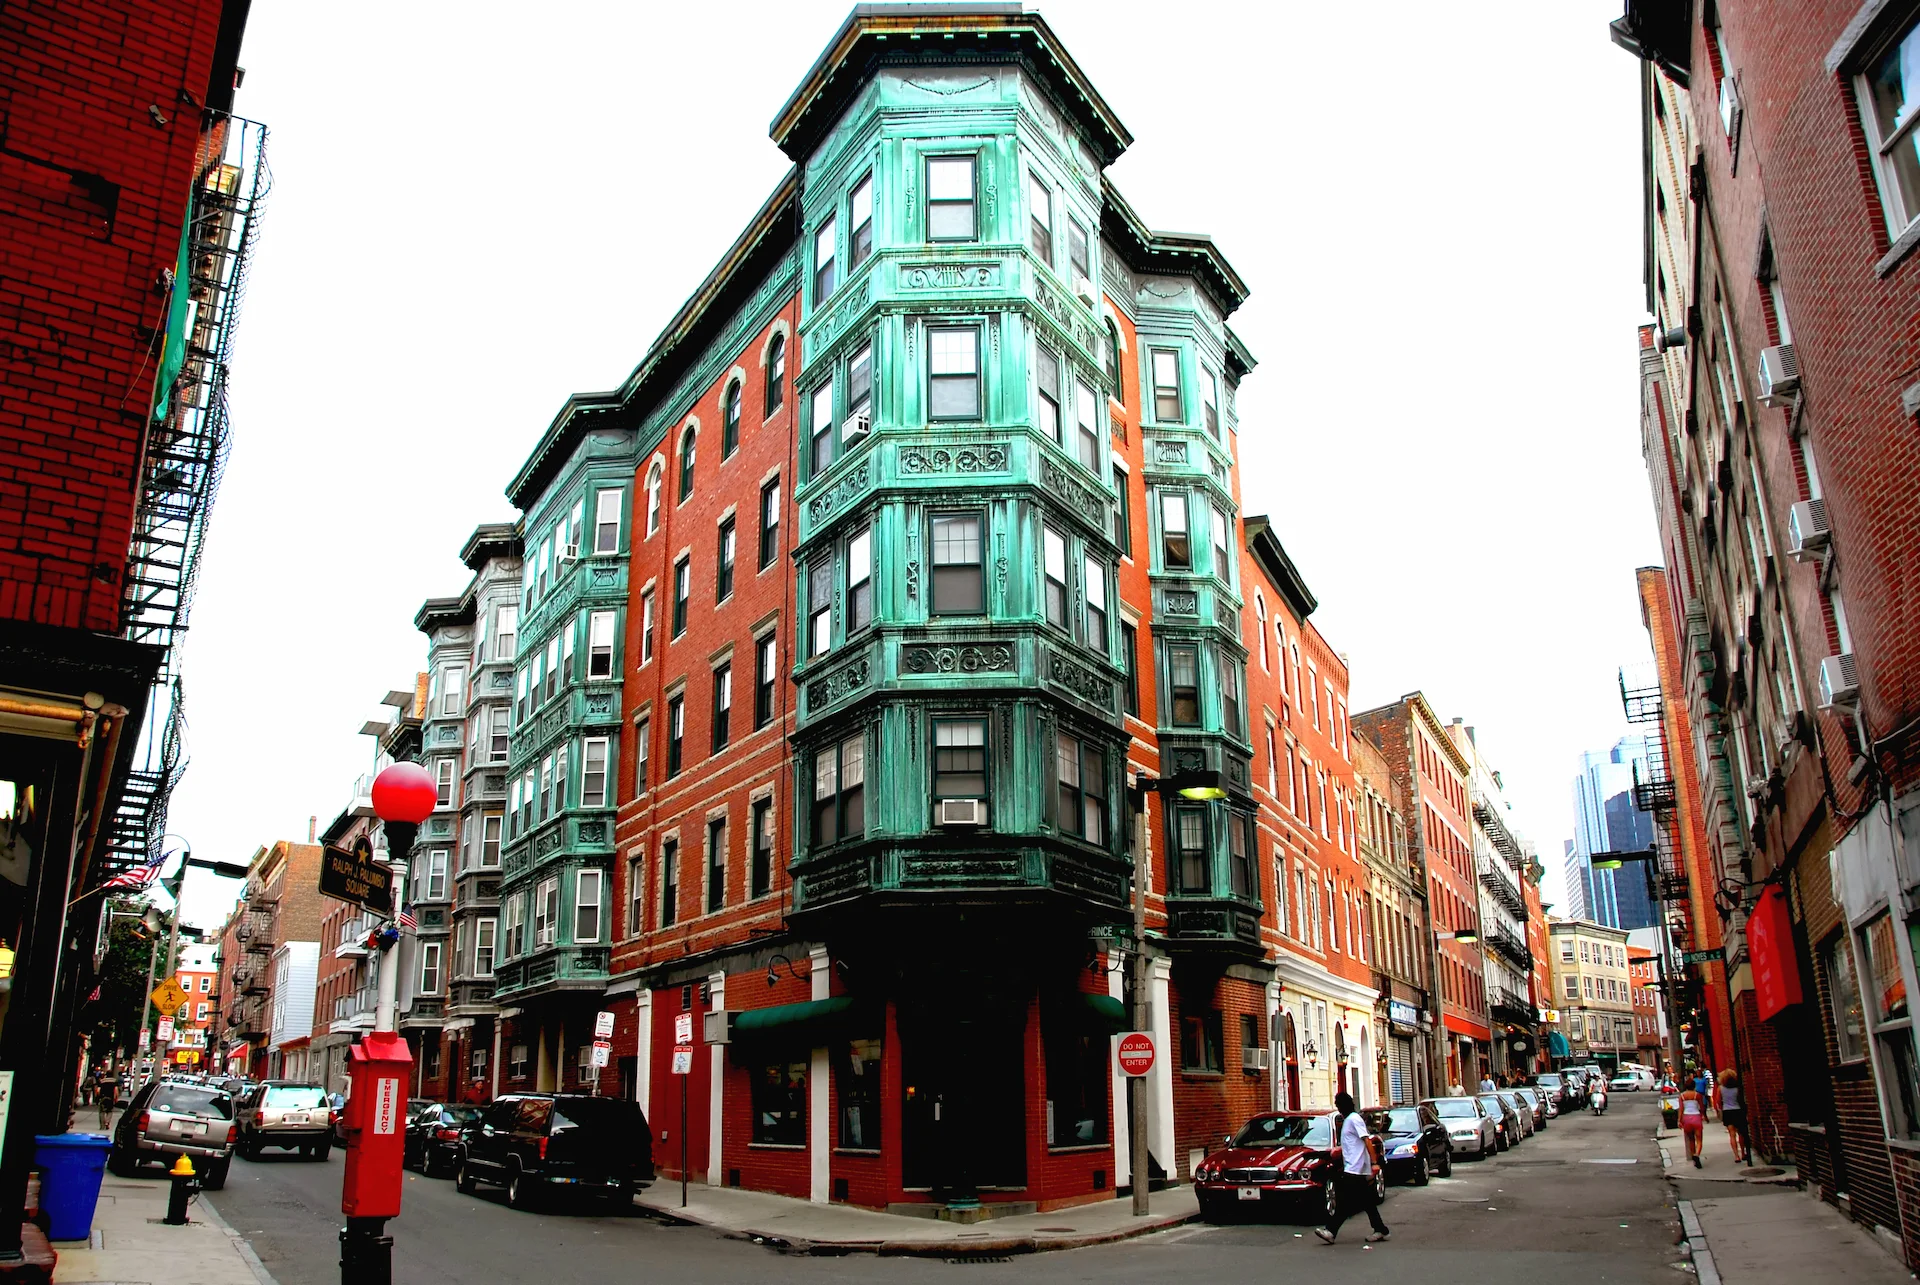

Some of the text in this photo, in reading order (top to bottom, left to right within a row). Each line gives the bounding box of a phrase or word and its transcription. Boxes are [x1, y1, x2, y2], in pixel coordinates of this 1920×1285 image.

[332, 857, 353, 876] RALPH
[360, 867, 385, 889] PALUMBO
[345, 878, 370, 899] SQUARE
[1135, 1042, 1149, 1050] NOT
[381, 1079, 391, 1134] EMERGENCY
